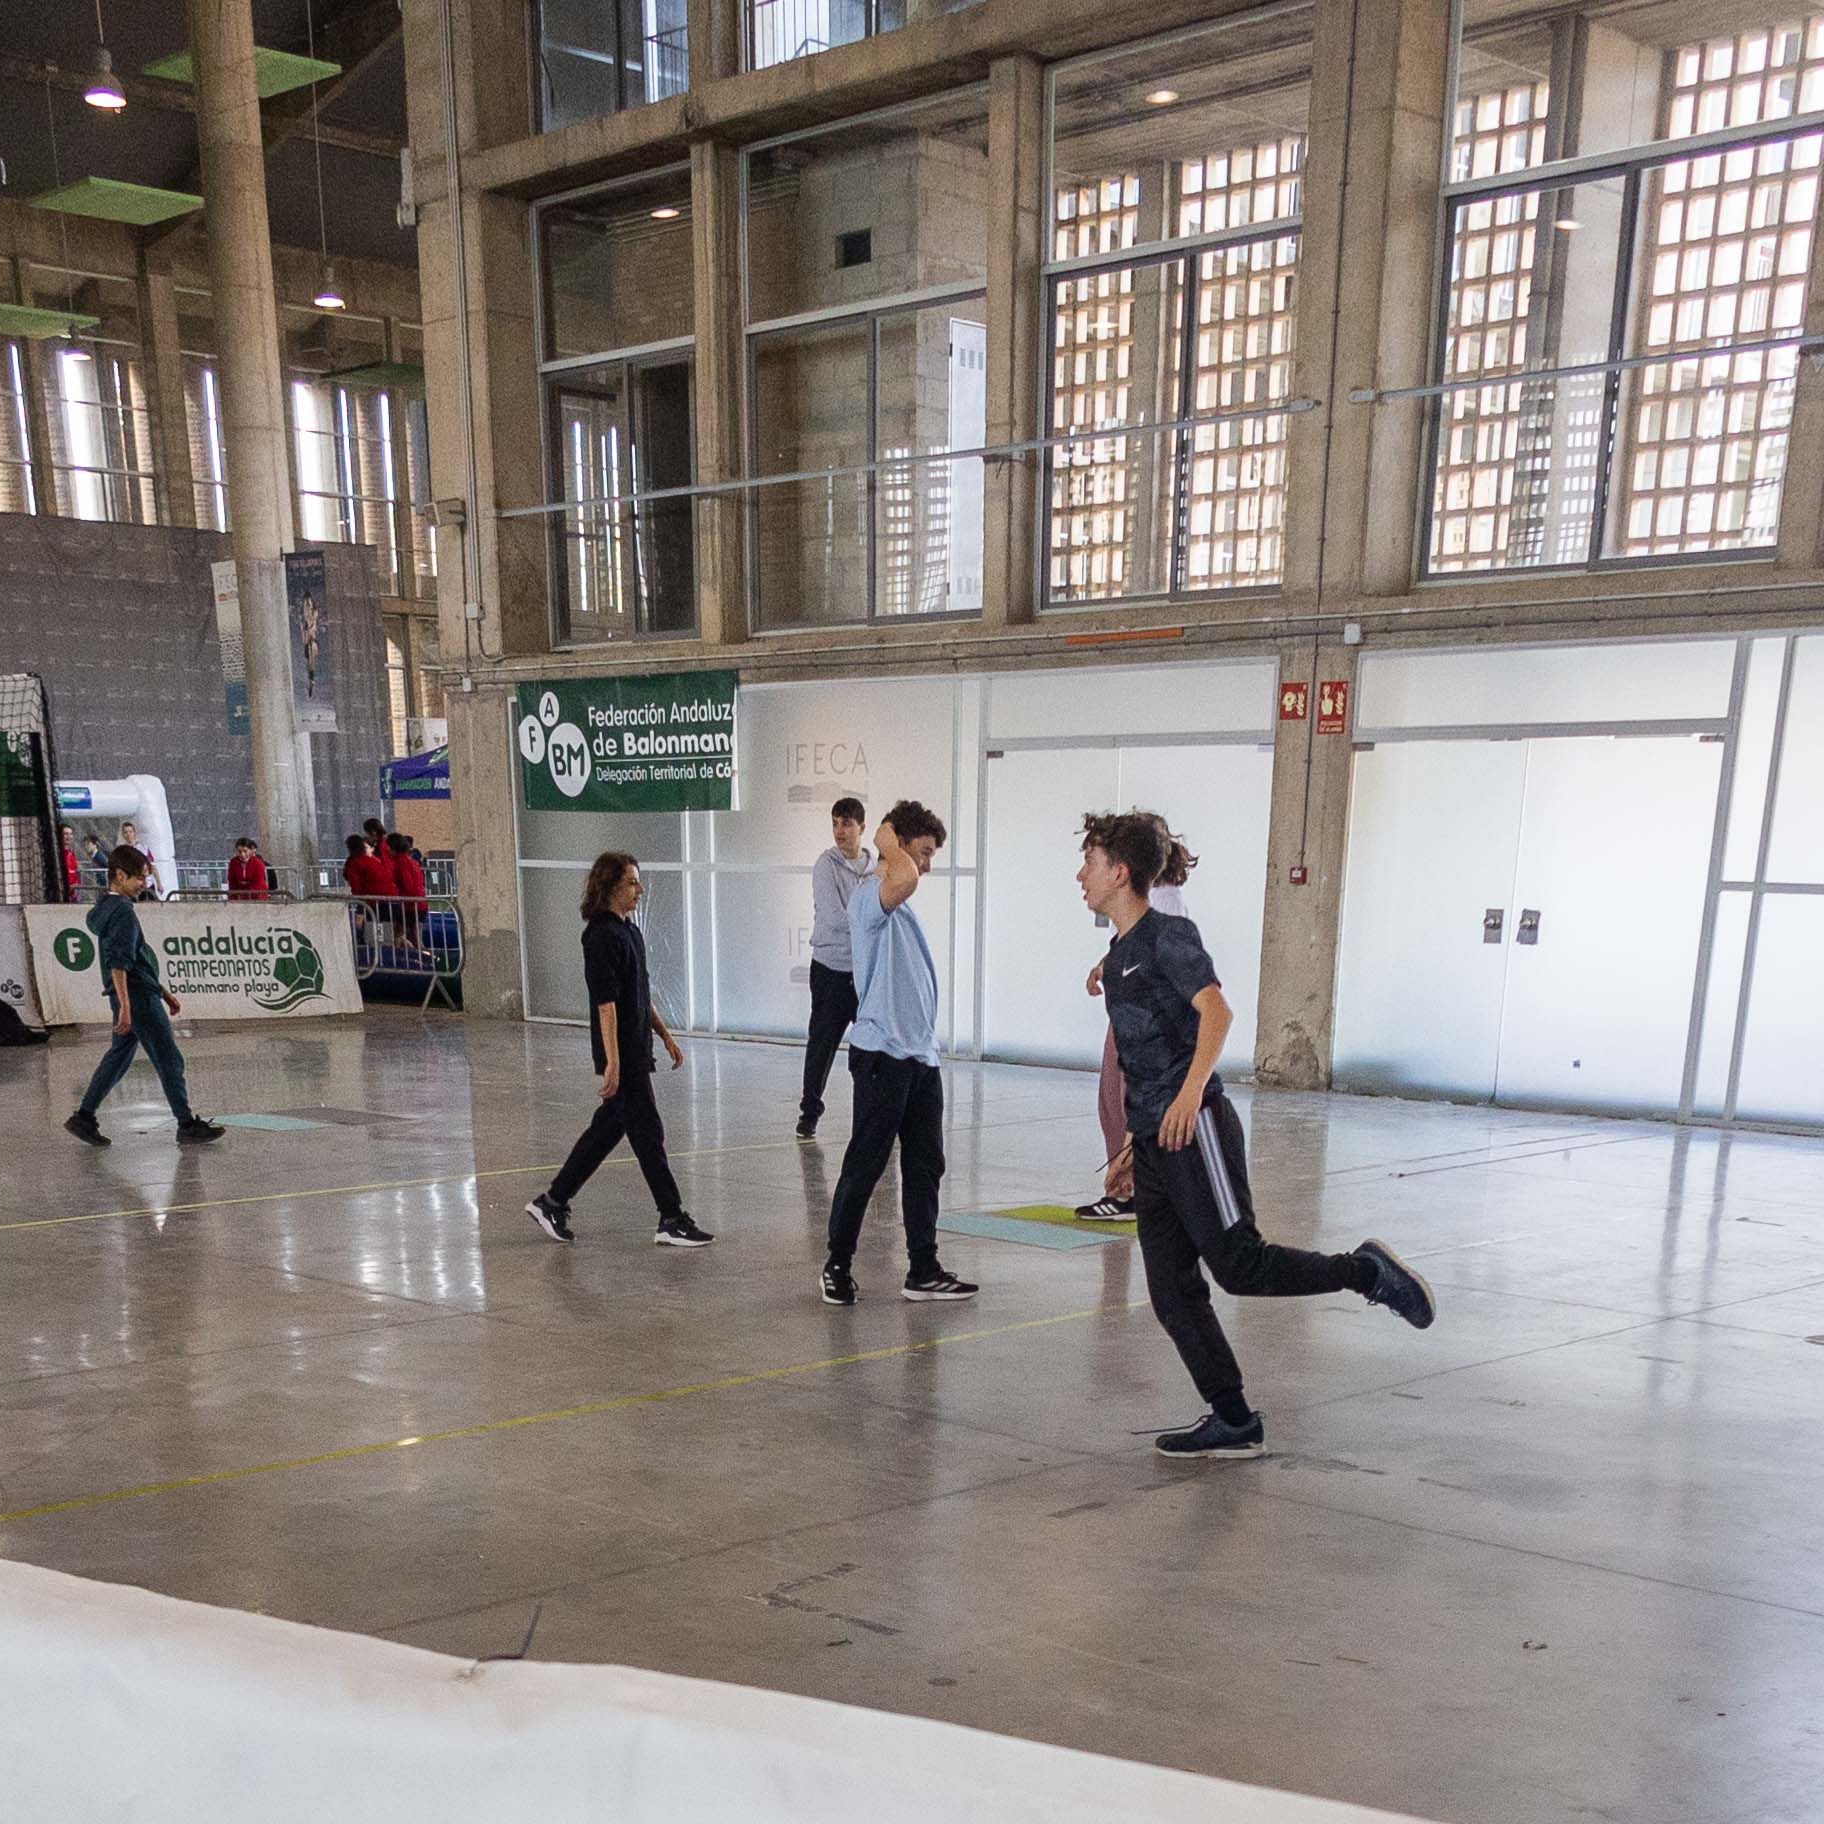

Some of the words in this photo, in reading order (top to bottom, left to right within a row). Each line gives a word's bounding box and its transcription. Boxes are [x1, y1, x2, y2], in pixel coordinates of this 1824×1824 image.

[544, 698, 555, 718] A
[588, 702, 666, 728] Federación
[528, 726, 537, 752] F
[593, 732, 617, 757] de
[552, 742, 585, 777] BM
[785, 743, 869, 775] IFECA
[596, 766, 648, 785] Delegación
[649, 763, 697, 781] Territorial
[700, 765, 714, 779] de
[66, 937, 81, 963] F
[162, 926, 293, 956] andalucía
[167, 959, 271, 978] CAMPEONATOS
[167, 979, 240, 995] balonmano
[244, 979, 279, 997] playa
